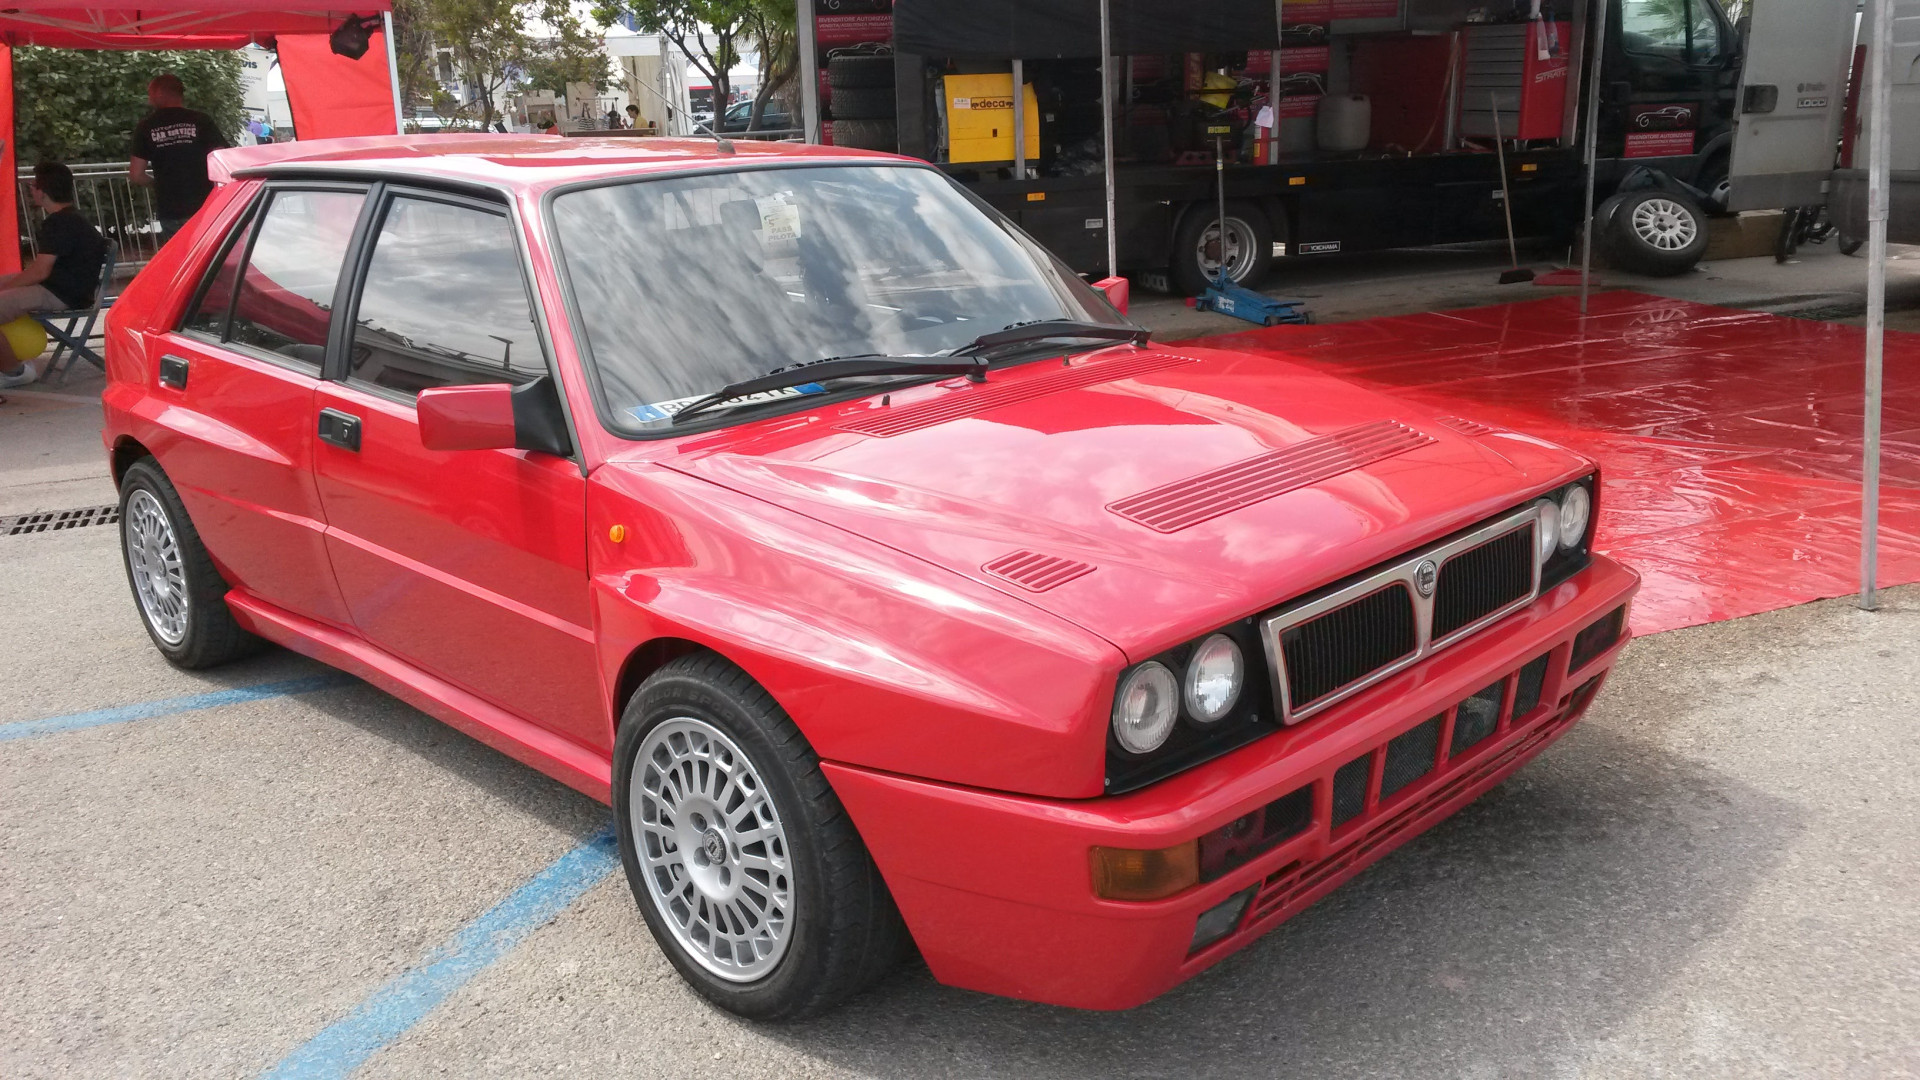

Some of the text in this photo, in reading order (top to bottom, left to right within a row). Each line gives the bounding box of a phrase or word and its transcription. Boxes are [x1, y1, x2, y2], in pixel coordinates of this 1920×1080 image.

[979, 98, 1006, 108] deca
[151, 131, 166, 142] CAR
[167, 127, 197, 138] SERVICE
[768, 232, 797, 241] PILOTA
[1310, 243, 1338, 251] YOKOHAMA
